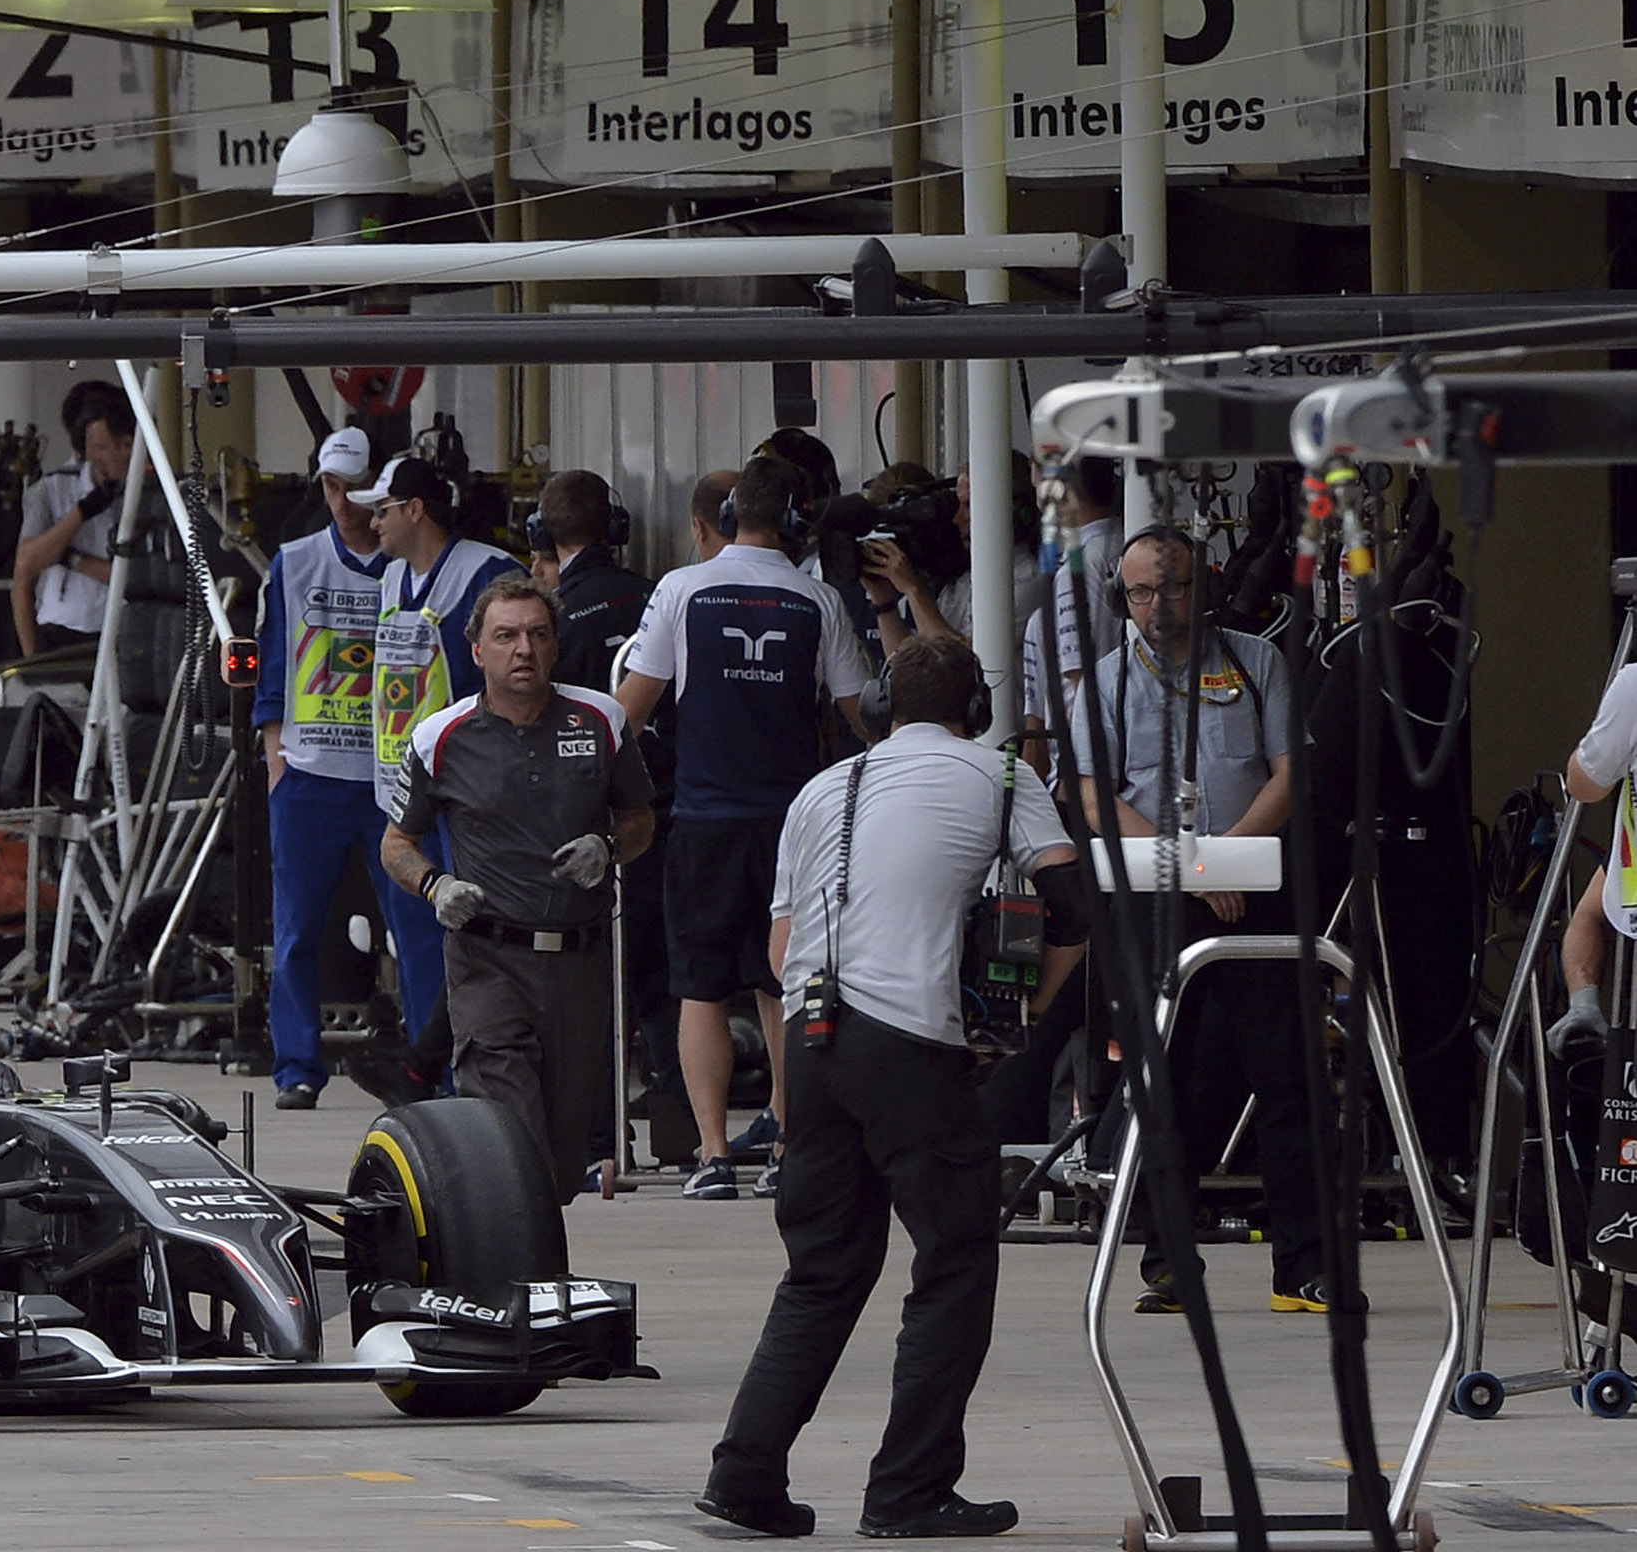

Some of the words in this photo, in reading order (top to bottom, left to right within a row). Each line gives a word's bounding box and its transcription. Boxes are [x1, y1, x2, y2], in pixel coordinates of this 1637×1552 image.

[257, 11, 401, 104] 13
[587, 96, 814, 152] Interlagos
[1012, 92, 1266, 145] Interagos
[694, 596, 740, 606] WILLIAMS
[567, 600, 610, 621] WILLIAMS
[723, 666, 784, 683] randstad
[561, 742, 596, 755] NEC
[101, 1134, 197, 1146] telcel
[149, 1178, 250, 1190] PIRELLI
[164, 1194, 270, 1208] NEC
[418, 1290, 507, 1323] telcel
